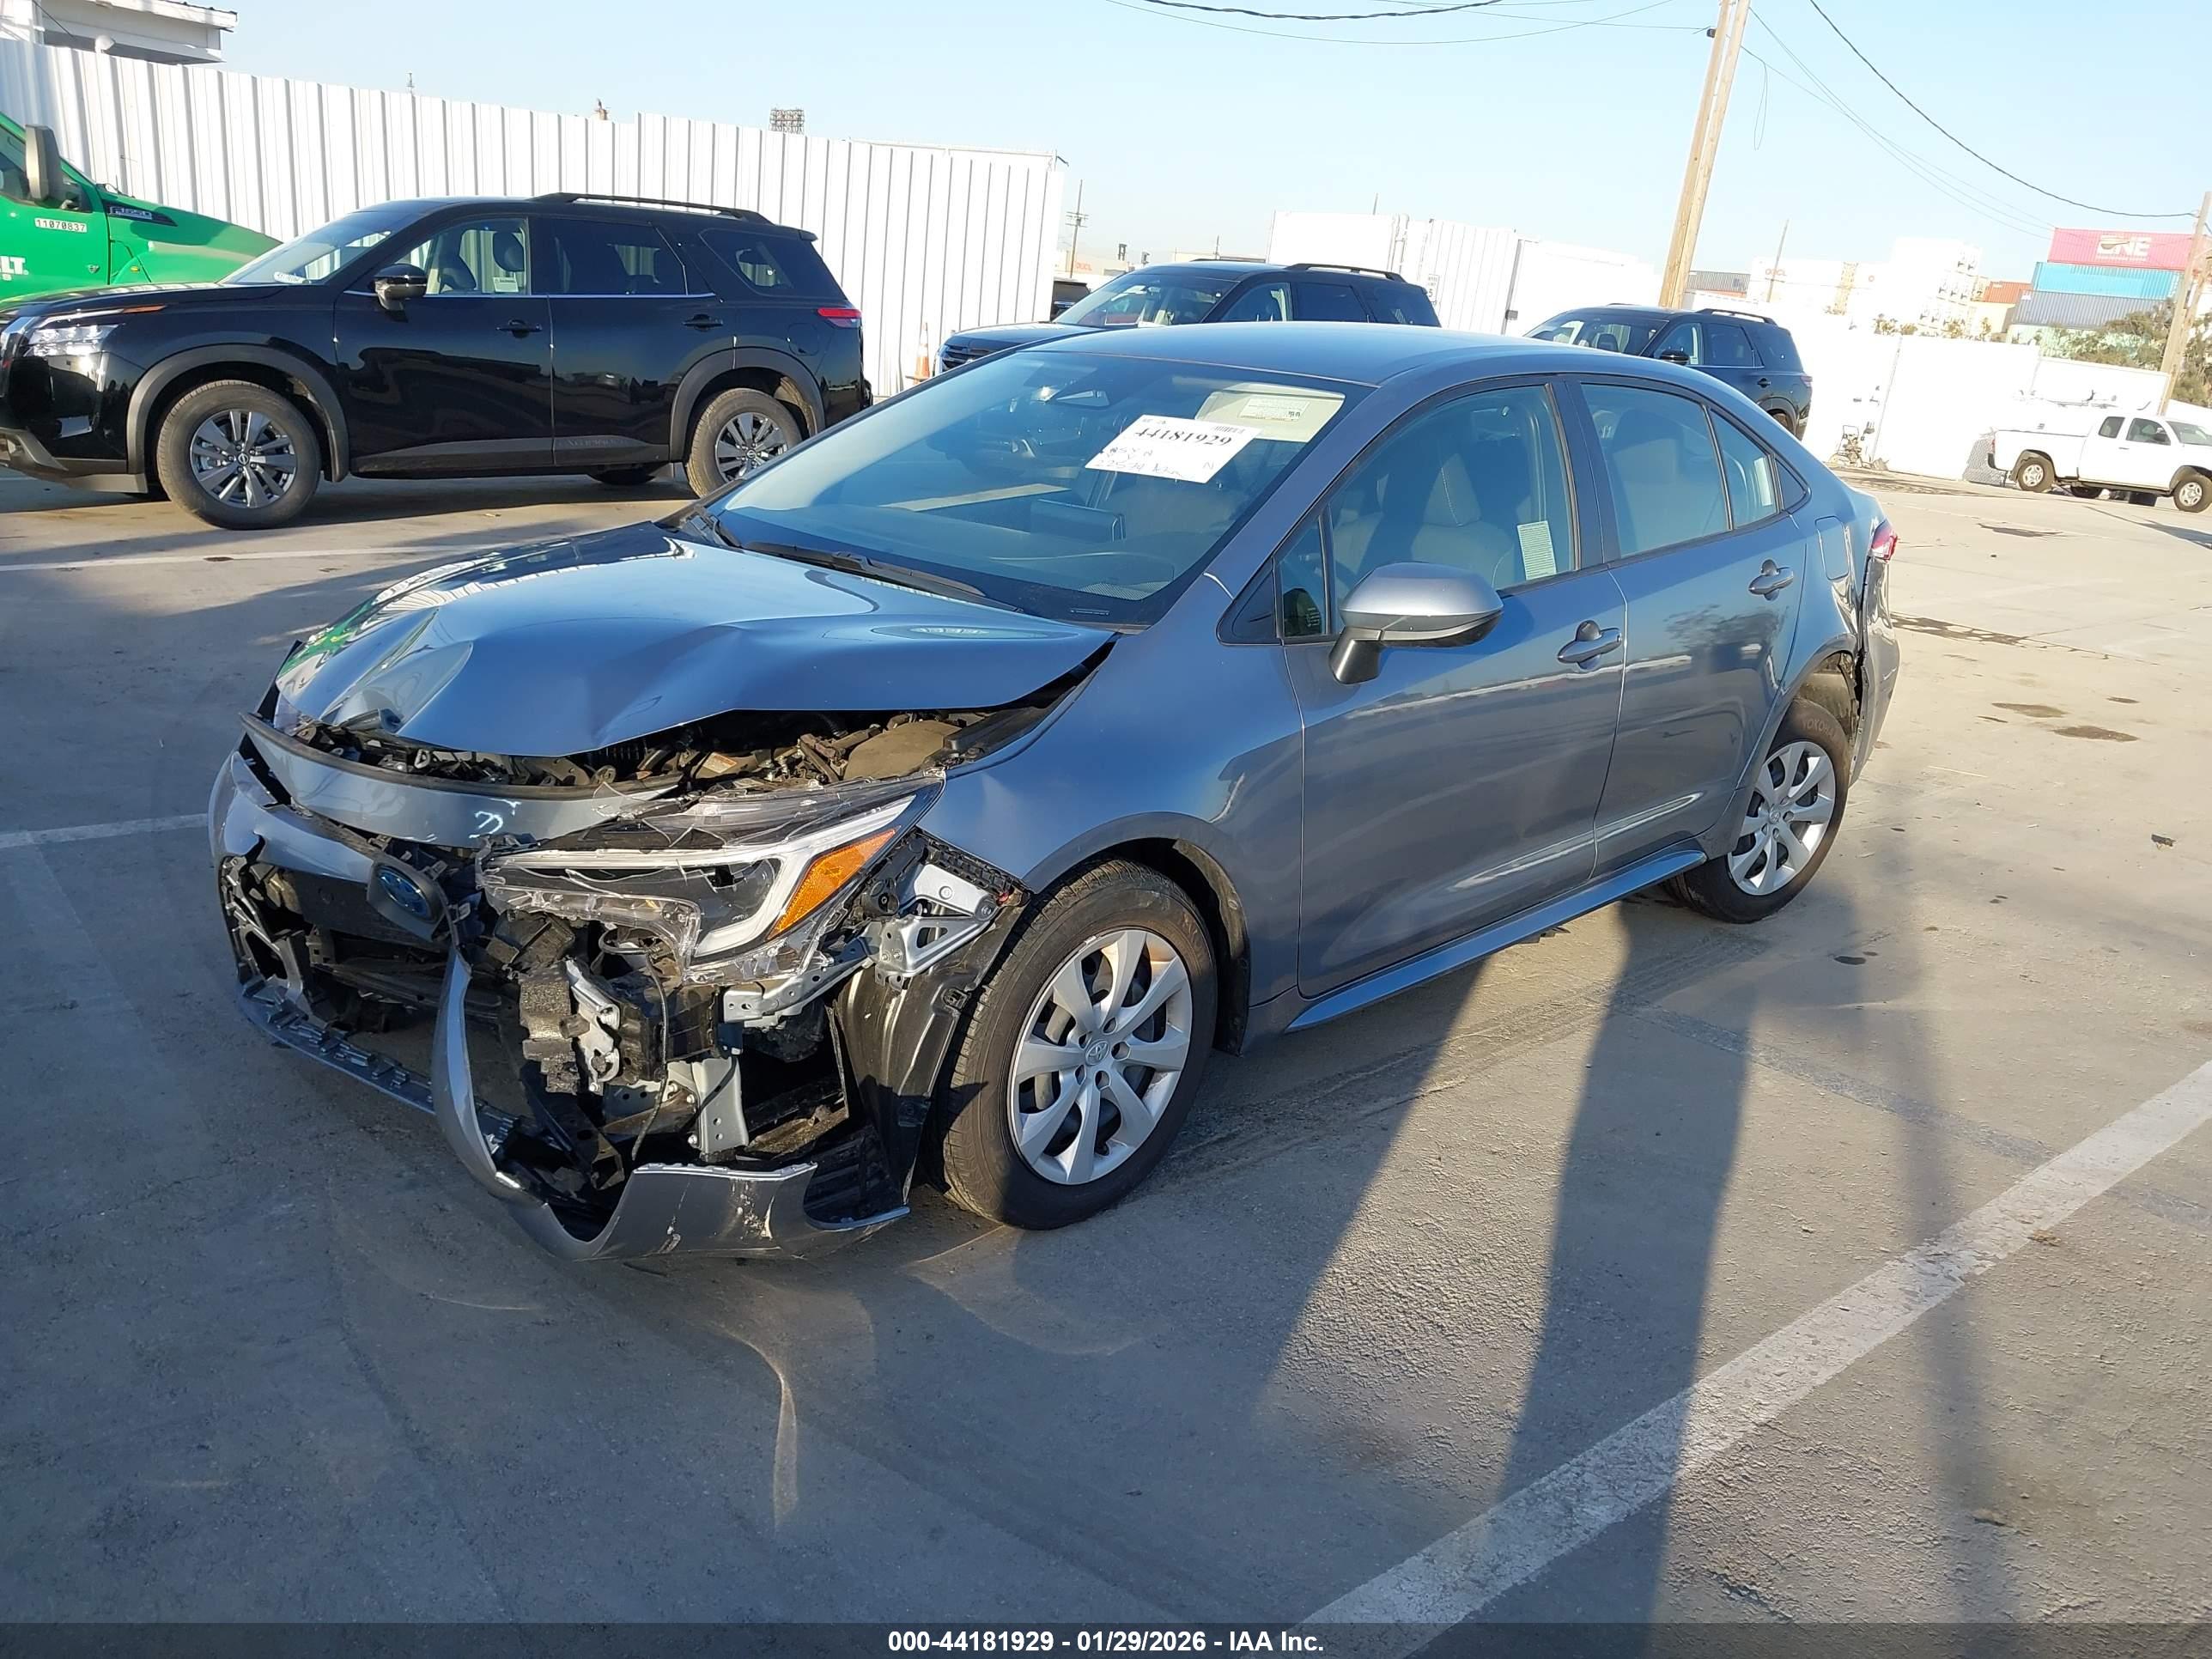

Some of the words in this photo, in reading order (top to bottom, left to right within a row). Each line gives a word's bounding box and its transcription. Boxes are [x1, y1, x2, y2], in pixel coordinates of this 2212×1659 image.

[36, 219, 86, 232] 11070837
[0, 256, 26, 275] LT
[1133, 428, 1233, 447] 44181929
